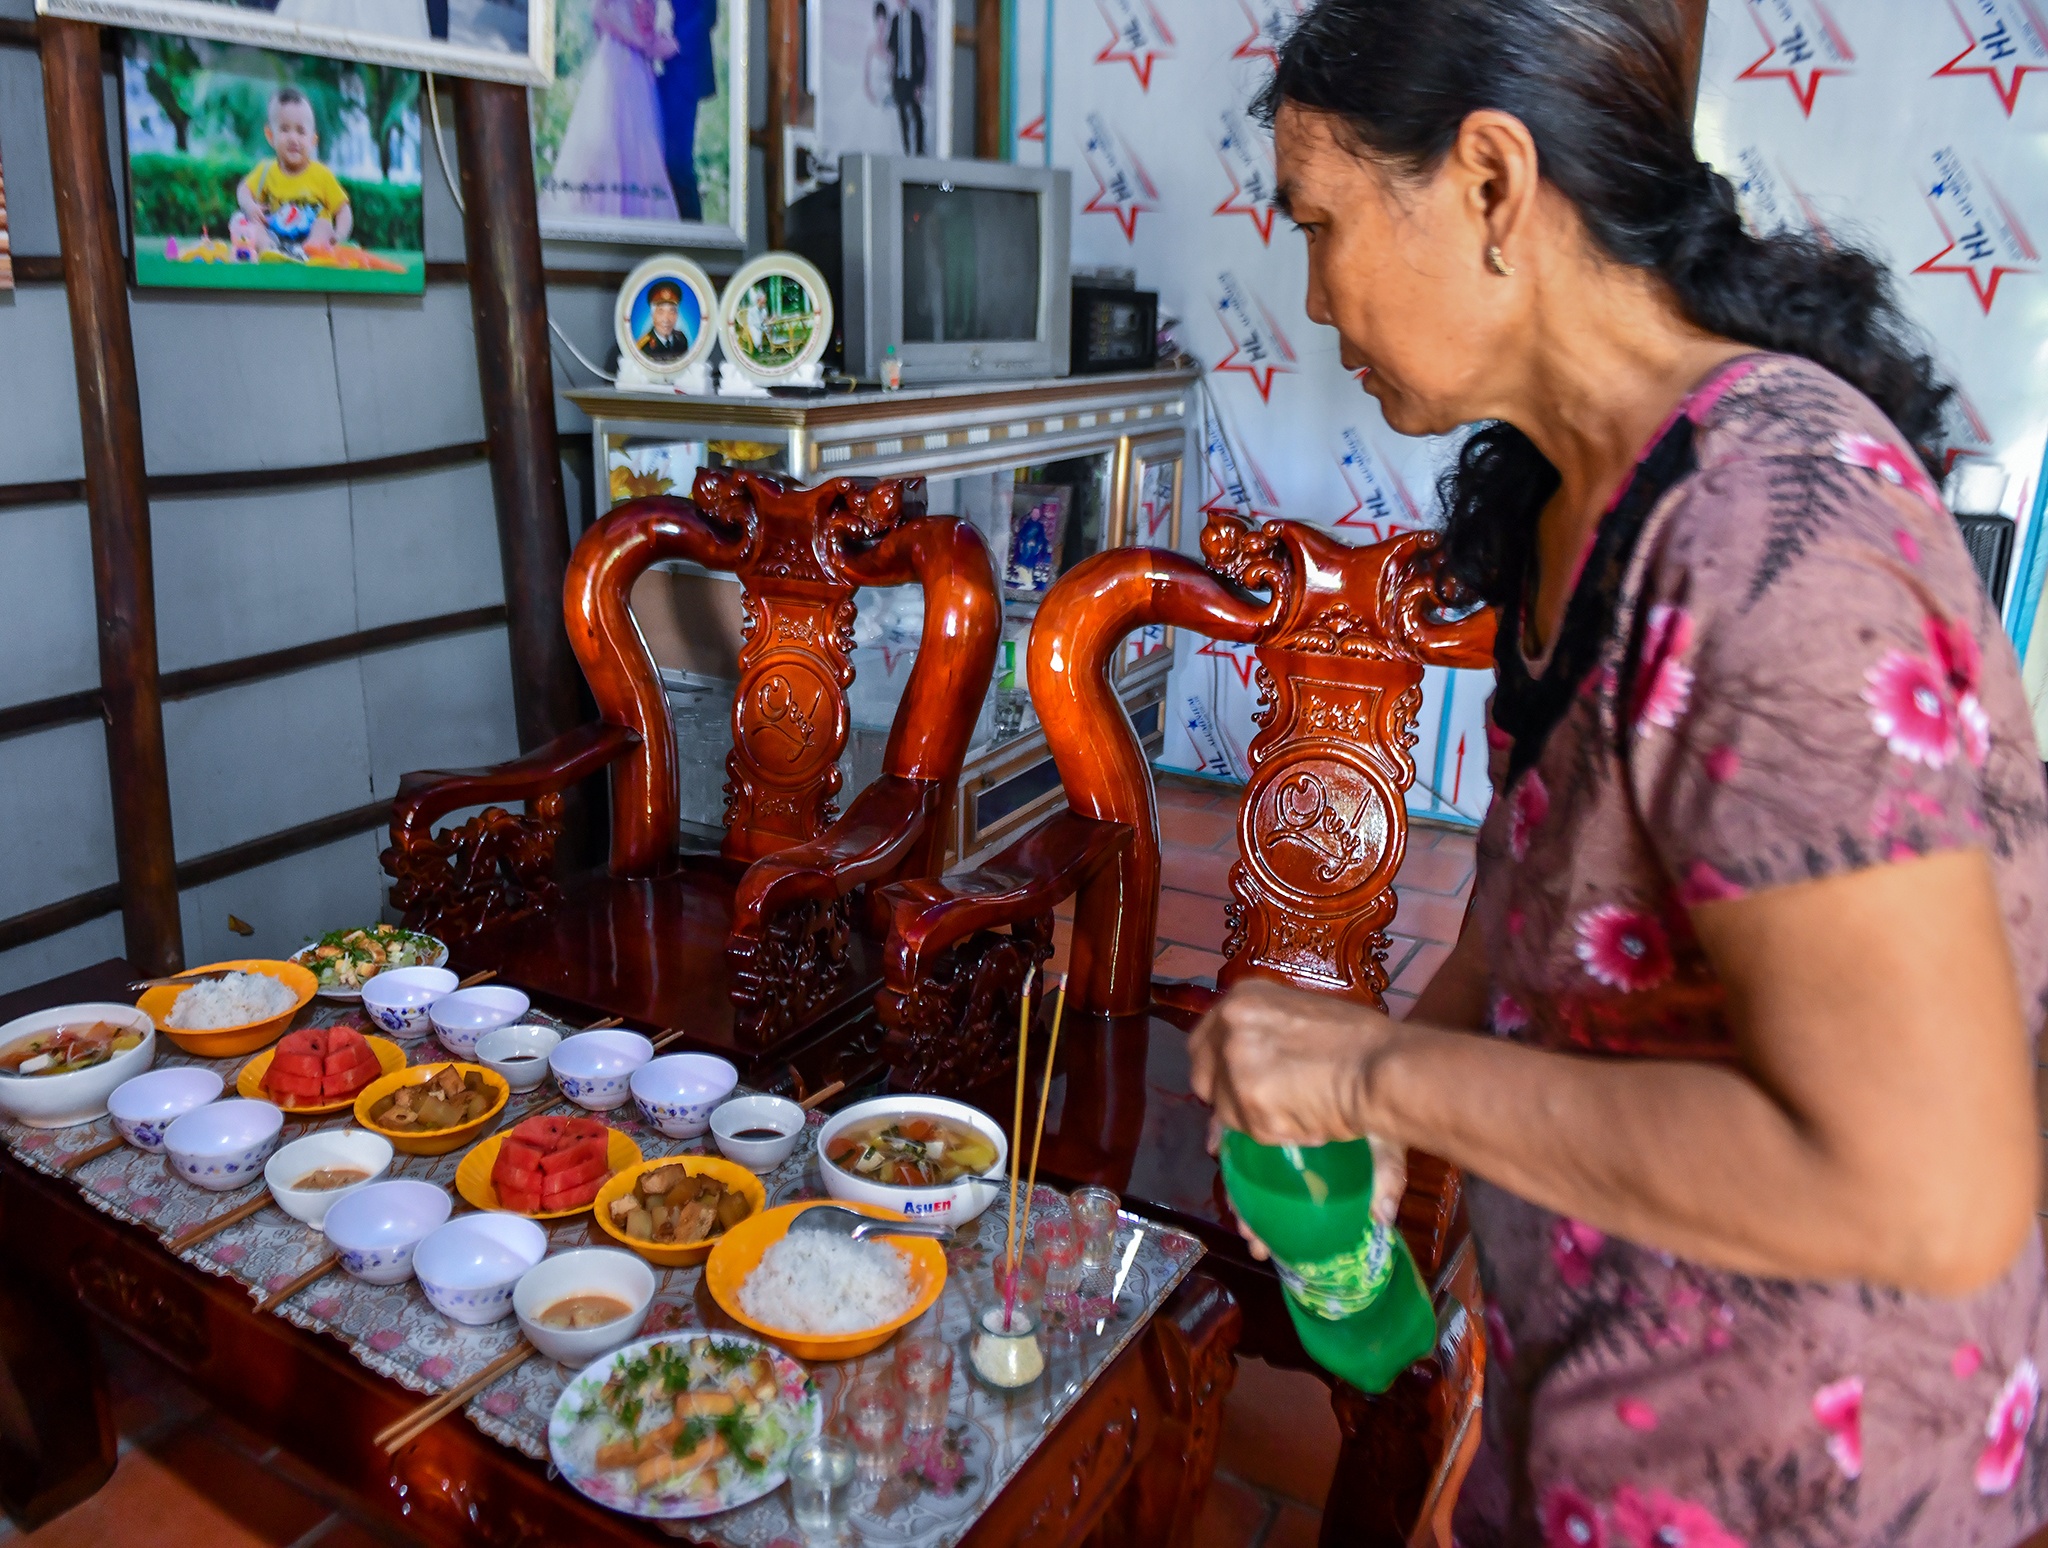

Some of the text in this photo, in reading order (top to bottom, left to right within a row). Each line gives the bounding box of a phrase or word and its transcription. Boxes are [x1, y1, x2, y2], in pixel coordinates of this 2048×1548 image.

[1781, 24, 1814, 65] HL
[1980, 20, 2017, 62] HL
[1109, 169, 1132, 204] HL
[1243, 170, 1267, 203] HL
[1959, 220, 1995, 262] HL
[1242, 331, 1268, 363] HL
[1365, 492, 1390, 519] HL
[1208, 751, 1232, 777] HL
